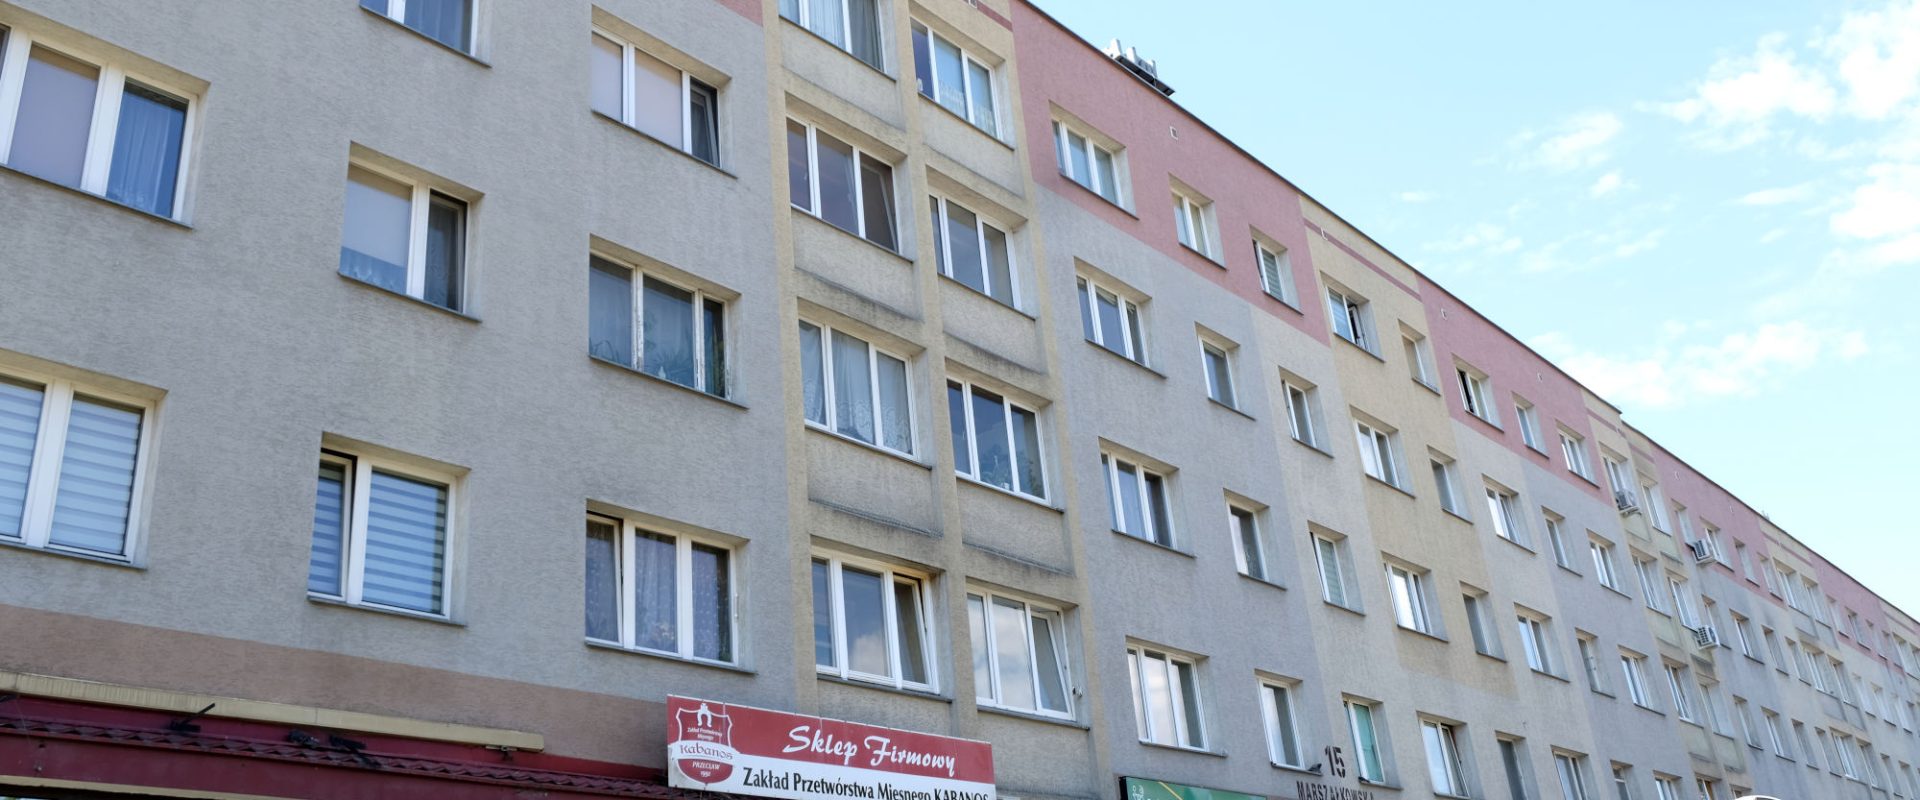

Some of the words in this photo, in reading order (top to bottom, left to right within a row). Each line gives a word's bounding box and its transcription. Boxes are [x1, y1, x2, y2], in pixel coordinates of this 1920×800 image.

[680, 742, 733, 760] Kabanos
[782, 725, 858, 766] Sklep
[864, 735, 955, 777] Firmowy
[1324, 745, 1346, 778] 15
[743, 767, 789, 791] Zakład
[793, 773, 874, 799] Przetwórstwa
